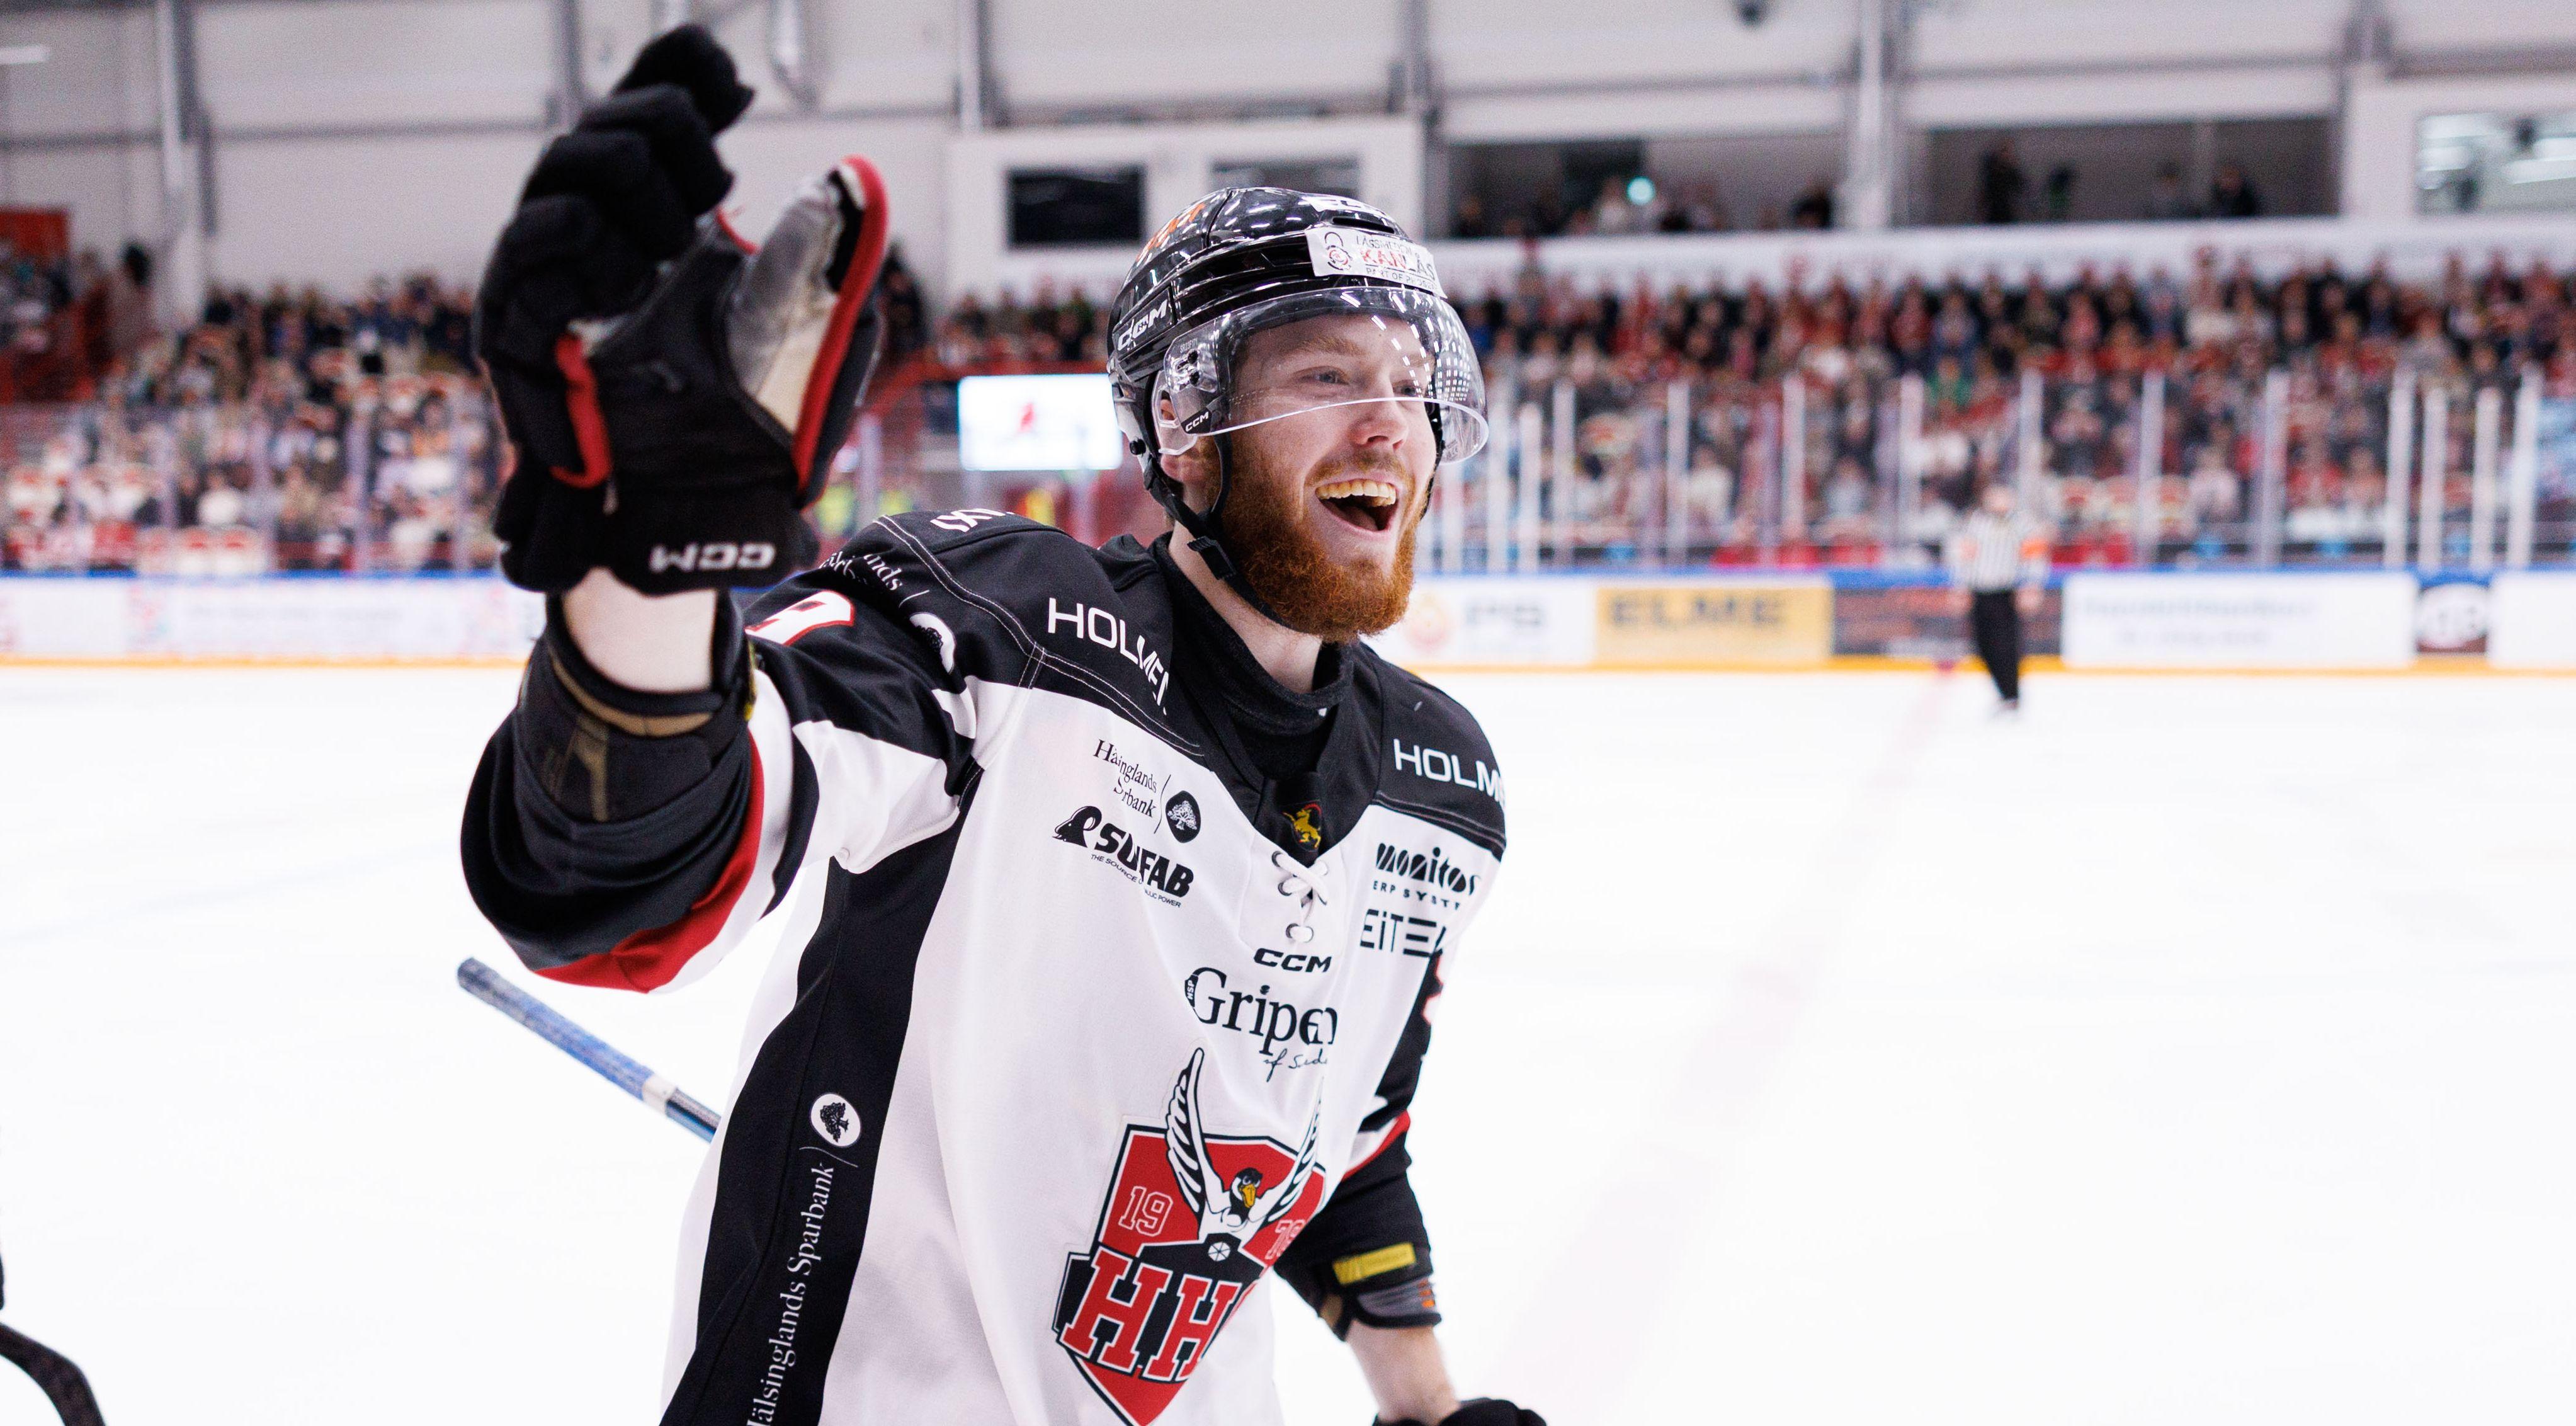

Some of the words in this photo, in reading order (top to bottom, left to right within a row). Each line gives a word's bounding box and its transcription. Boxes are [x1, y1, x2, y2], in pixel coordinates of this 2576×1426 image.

[1117, 299, 1167, 351] CCM
[1185, 411, 1209, 432] CCM
[1393, 738, 1505, 807] HOLM
[1090, 853, 1105, 863] THE
[1105, 858, 1138, 882] SOURCE
[1157, 894, 1182, 908] POWER
[1373, 880, 1396, 894] ERP
[1402, 888, 1461, 911] SYSTE
[1253, 947, 1332, 973] CCM
[1184, 966, 1338, 1056] Gripen
[1118, 1185, 1174, 1237] 19
[747, 1280, 807, 1426] älsinglands
[786, 1162, 835, 1277] Sparbank
[1059, 1245, 1244, 1383] HH
